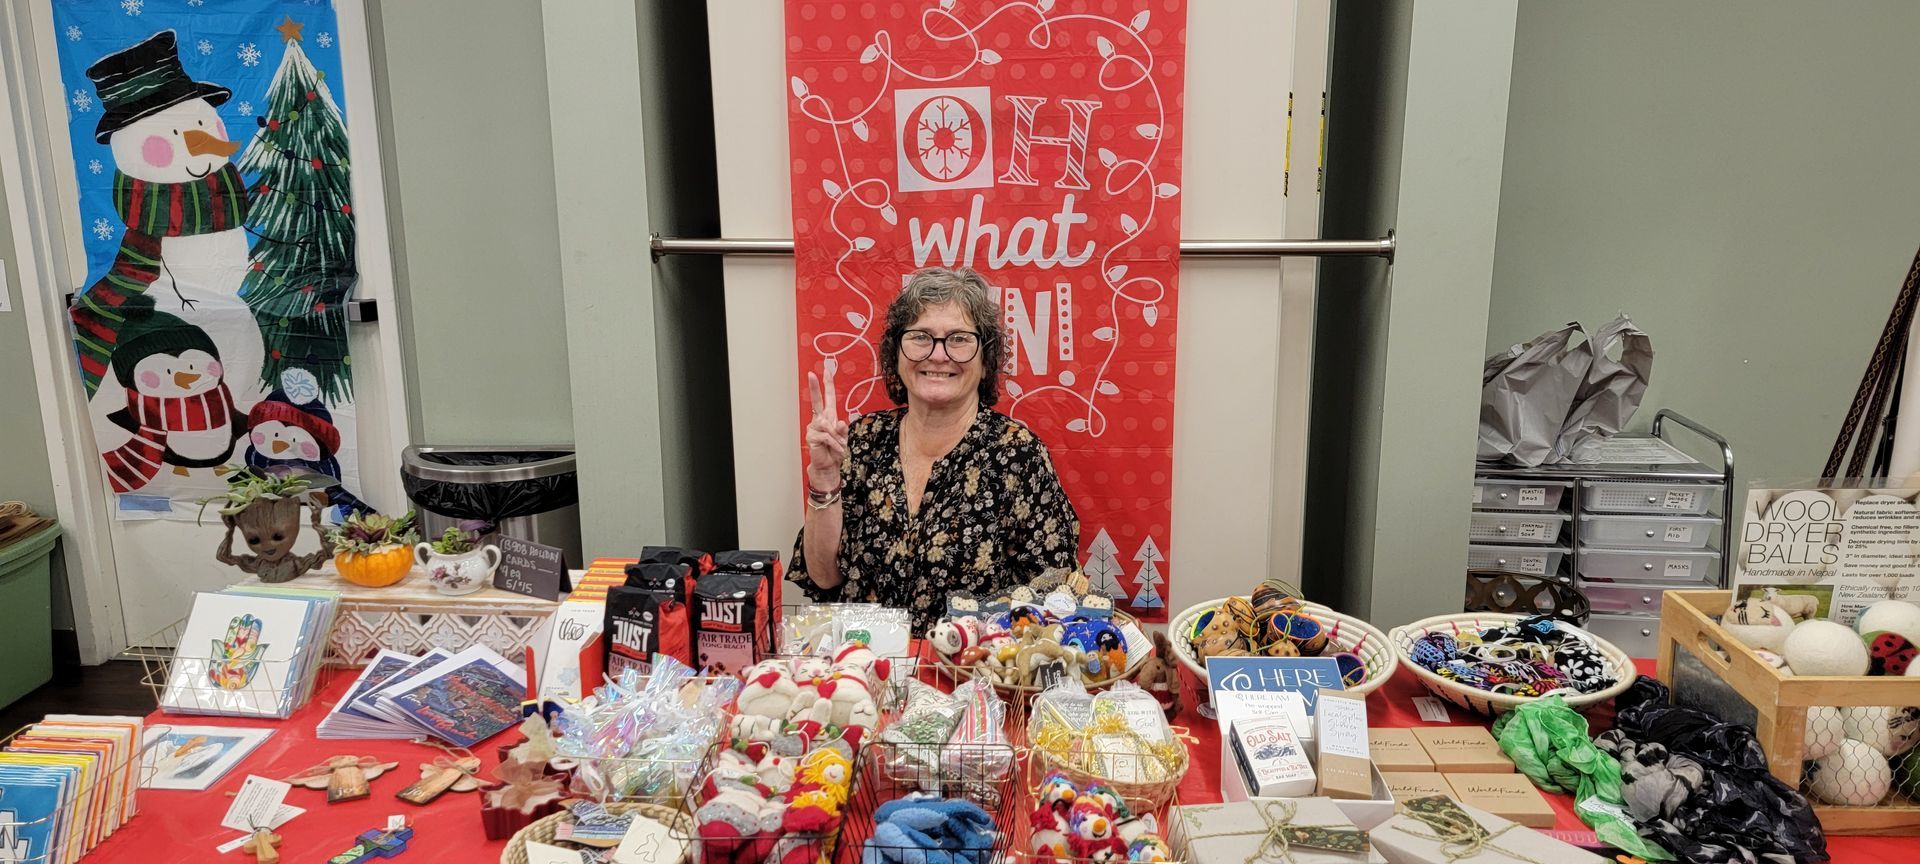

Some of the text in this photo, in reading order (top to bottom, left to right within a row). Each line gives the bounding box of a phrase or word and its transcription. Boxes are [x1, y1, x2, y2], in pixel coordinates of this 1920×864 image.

[902, 95, 1102, 190] OH
[909, 194, 1096, 270] what
[1756, 500, 1847, 521] WOOL
[1744, 522, 1844, 543] DRYER
[505, 553, 537, 571] CARDS
[529, 545, 560, 564] HOLIDAY
[1747, 543, 1840, 565] BALLS
[1743, 569, 1838, 578] Handmade in Nepal
[700, 600, 745, 625] JUST
[558, 618, 591, 641] theo
[611, 620, 652, 653] JUST
[697, 632, 752, 644] FAIR TRADE
[1258, 668, 1334, 688] HERE
[1136, 717, 1155, 730] God
[1246, 732, 1267, 748] OLD
[1266, 728, 1293, 744] SALT
